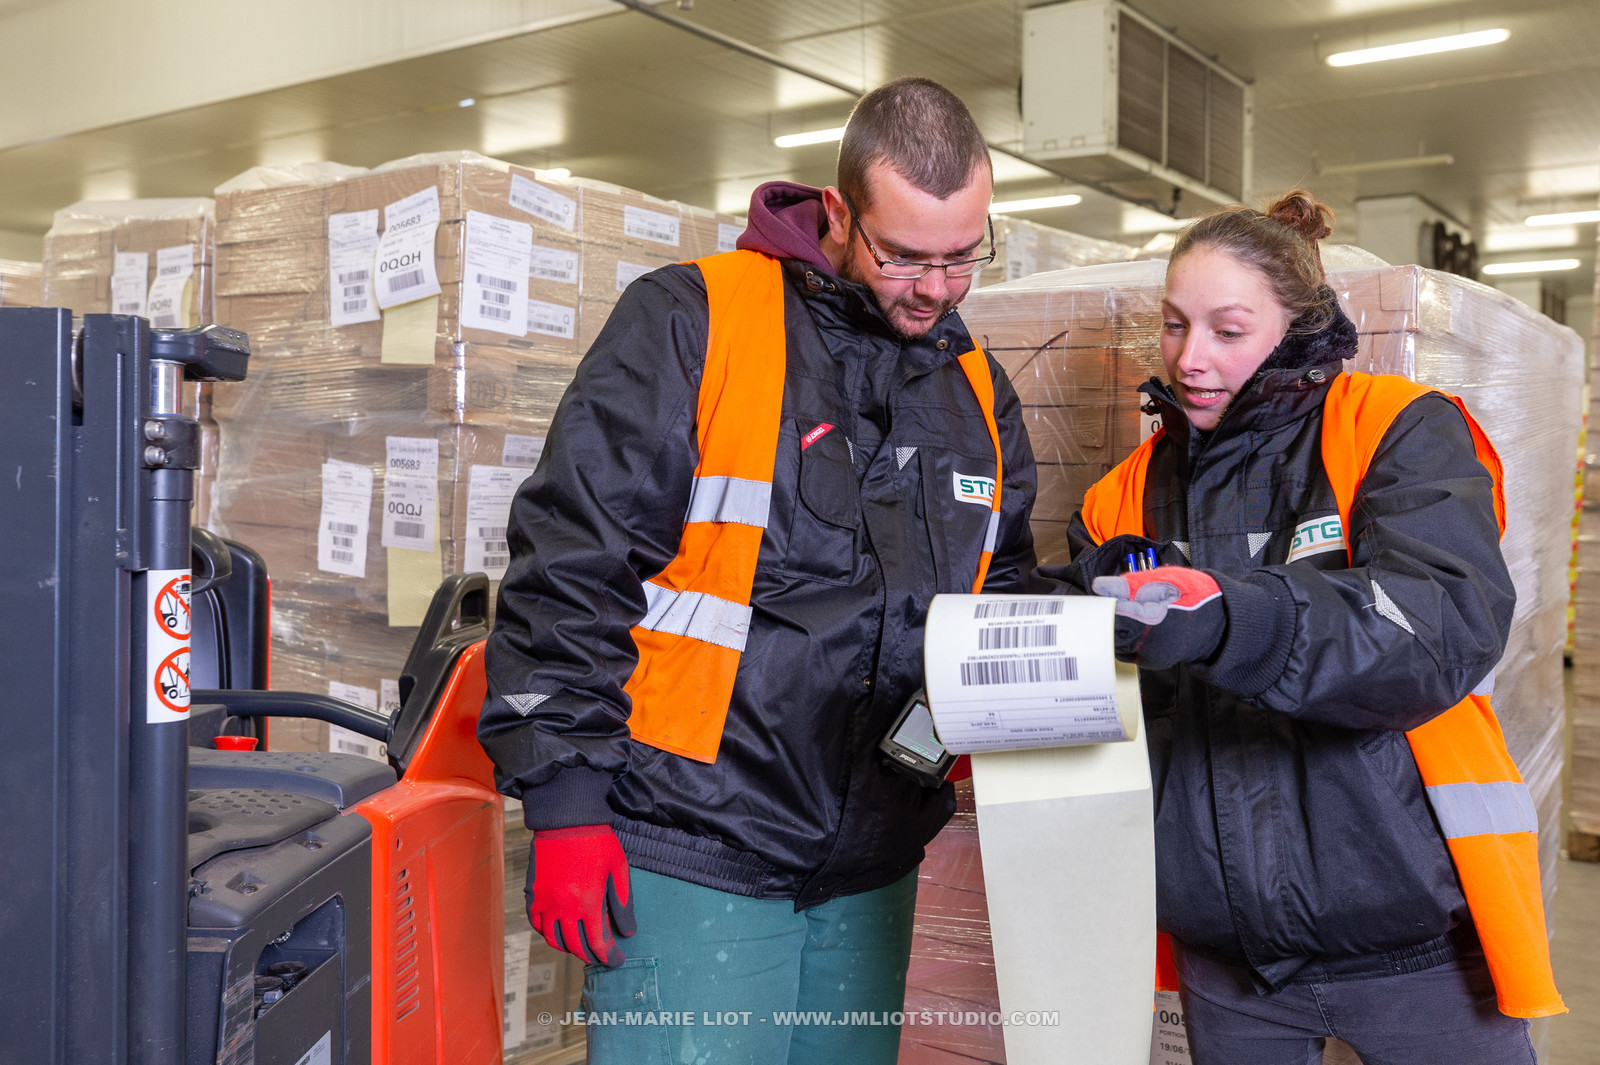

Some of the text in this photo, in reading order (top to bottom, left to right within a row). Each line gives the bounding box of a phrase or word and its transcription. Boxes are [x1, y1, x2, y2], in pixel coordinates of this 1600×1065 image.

[380, 250, 422, 273] 0QQH
[390, 457, 421, 471] 005683
[388, 501, 423, 517] 0QQJ
